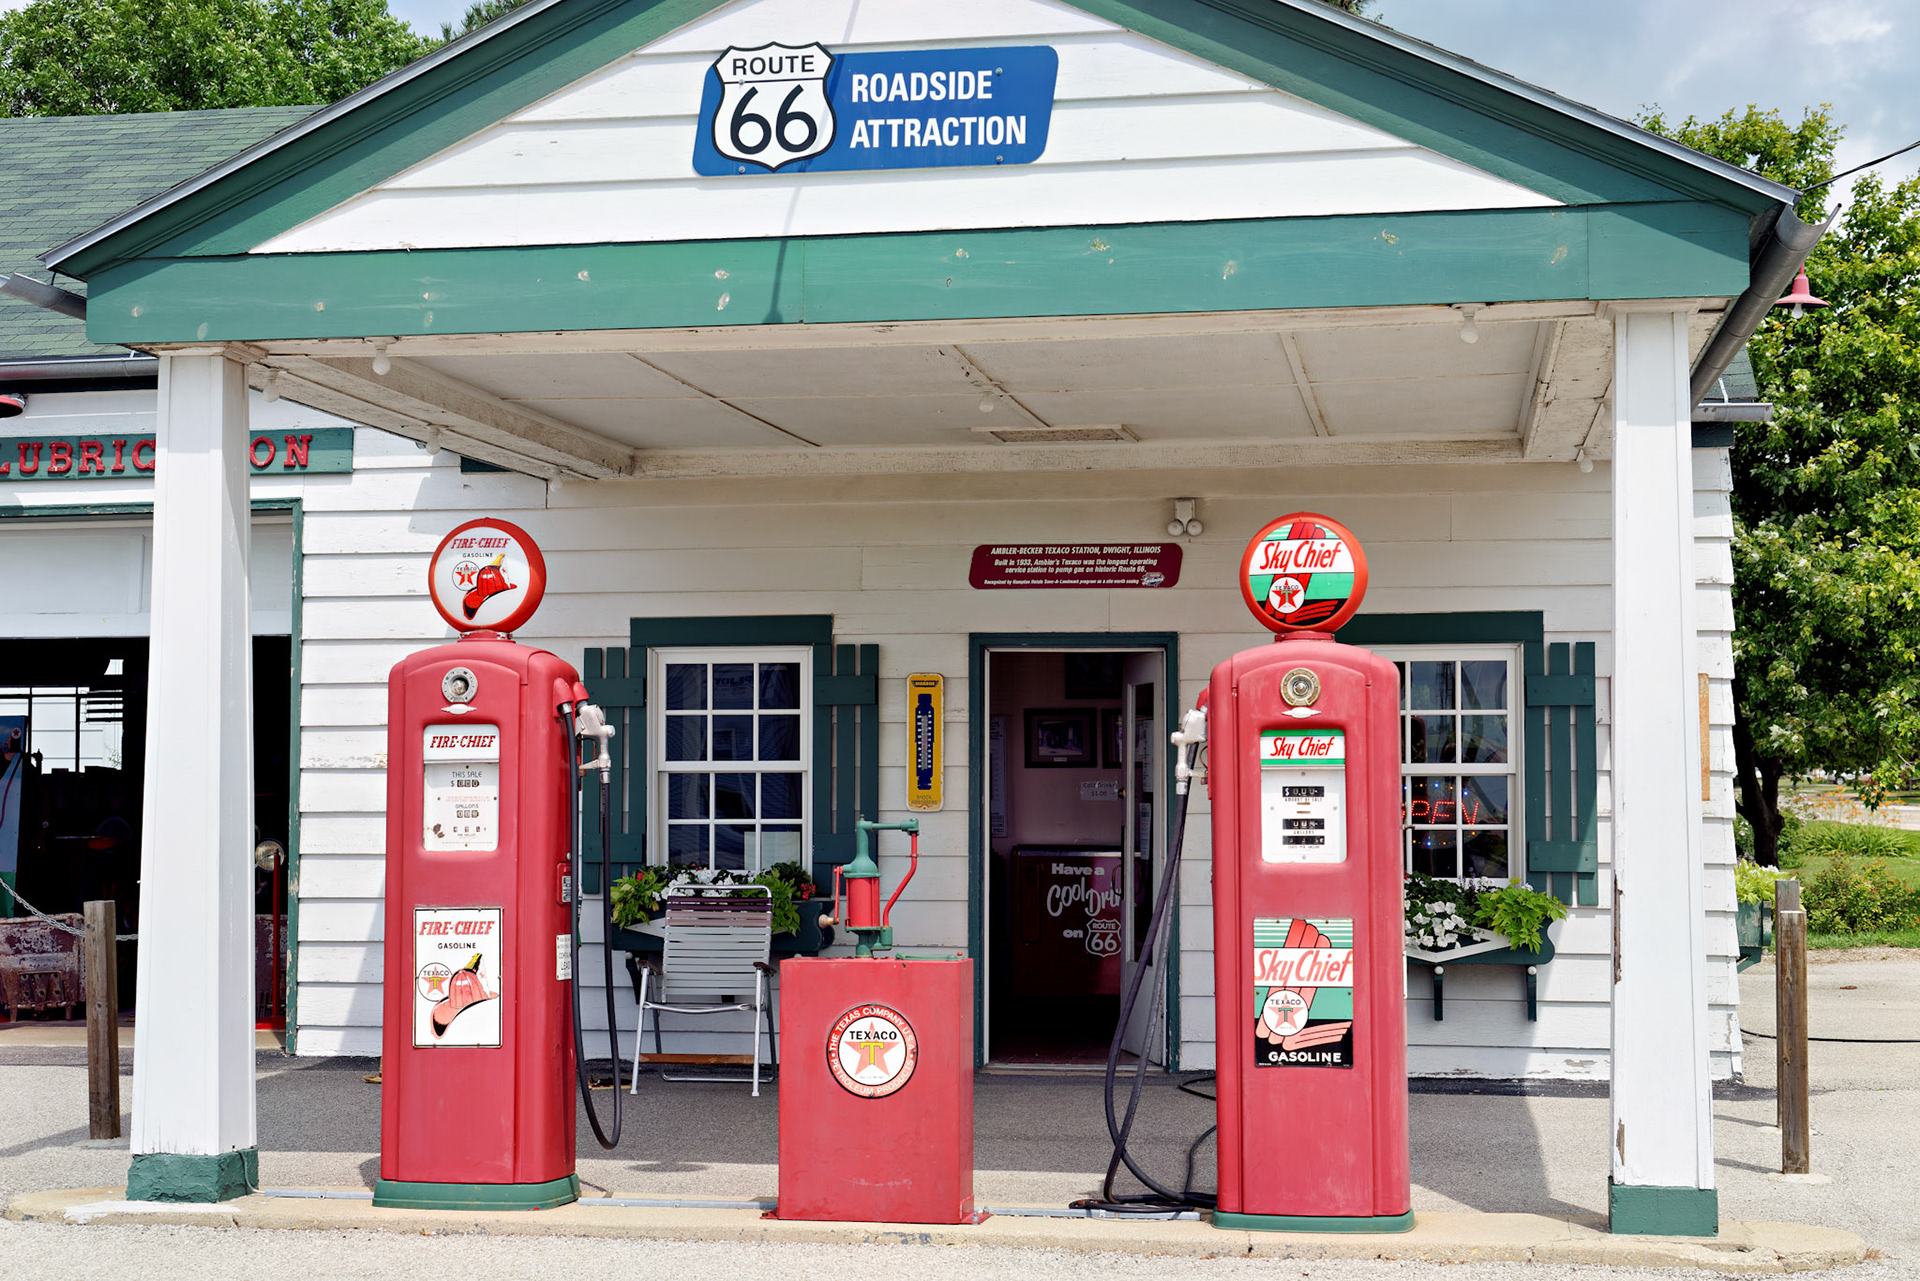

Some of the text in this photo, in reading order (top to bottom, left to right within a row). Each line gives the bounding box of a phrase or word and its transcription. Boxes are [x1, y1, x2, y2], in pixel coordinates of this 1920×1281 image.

[732, 54, 815, 76] ROUTE
[852, 70, 993, 103] ROADSIDE
[730, 85, 818, 155] 66
[849, 115, 1027, 149] ATTRACTION
[451, 537, 511, 549] FIRE-CHIEF
[991, 545, 1161, 555] AMBLER-BECKER TEXACO STATION, DWIGHT, ILLINOIS
[994, 559, 1008, 567] Built
[1034, 558, 1060, 566] Ambler's
[1061, 558, 1082, 566] Texaco
[1107, 558, 1129, 567] longest
[1130, 558, 1158, 567] operating
[1259, 540, 1342, 573] Sky Chief
[430, 735, 496, 748] FIRE-CHIEF
[1270, 737, 1334, 760] Sky Chief
[1052, 862, 1105, 876] Have a
[1047, 877, 1085, 917] Cool
[419, 921, 496, 936] FIRE-CHIEF
[1063, 929, 1083, 938] on
[438, 942, 477, 950] GASOLINE
[1091, 932, 1118, 951] 66
[1254, 949, 1353, 987] Sky Chief
[1270, 998, 1302, 1006] TEXACO
[830, 1033, 840, 1051] THE
[835, 1010, 861, 1032] TEXAS
[862, 1006, 905, 1026] COMPANY
[849, 1030, 897, 1041] TEXACO
[1268, 1051, 1343, 1063] GASOLINE
[831, 1059, 914, 1095] PETROLEUM PRODUCTS
